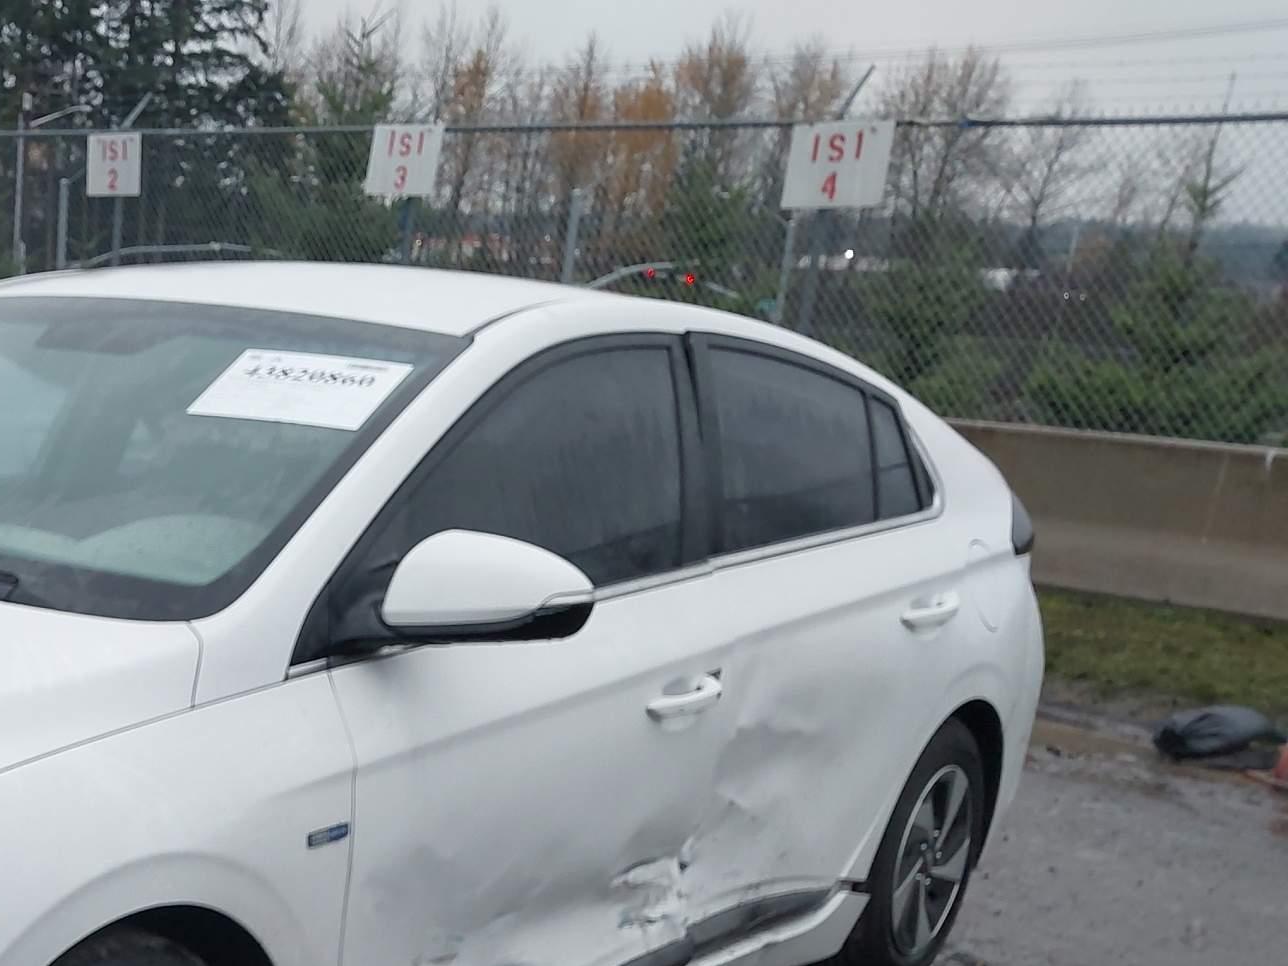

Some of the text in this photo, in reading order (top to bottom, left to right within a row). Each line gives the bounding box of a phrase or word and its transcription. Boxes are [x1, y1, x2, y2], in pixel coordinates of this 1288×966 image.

[107, 168, 119, 192] 2
[393, 165, 409, 192] 3
[820, 170, 838, 201] 4
[243, 364, 376, 387] 43820860
